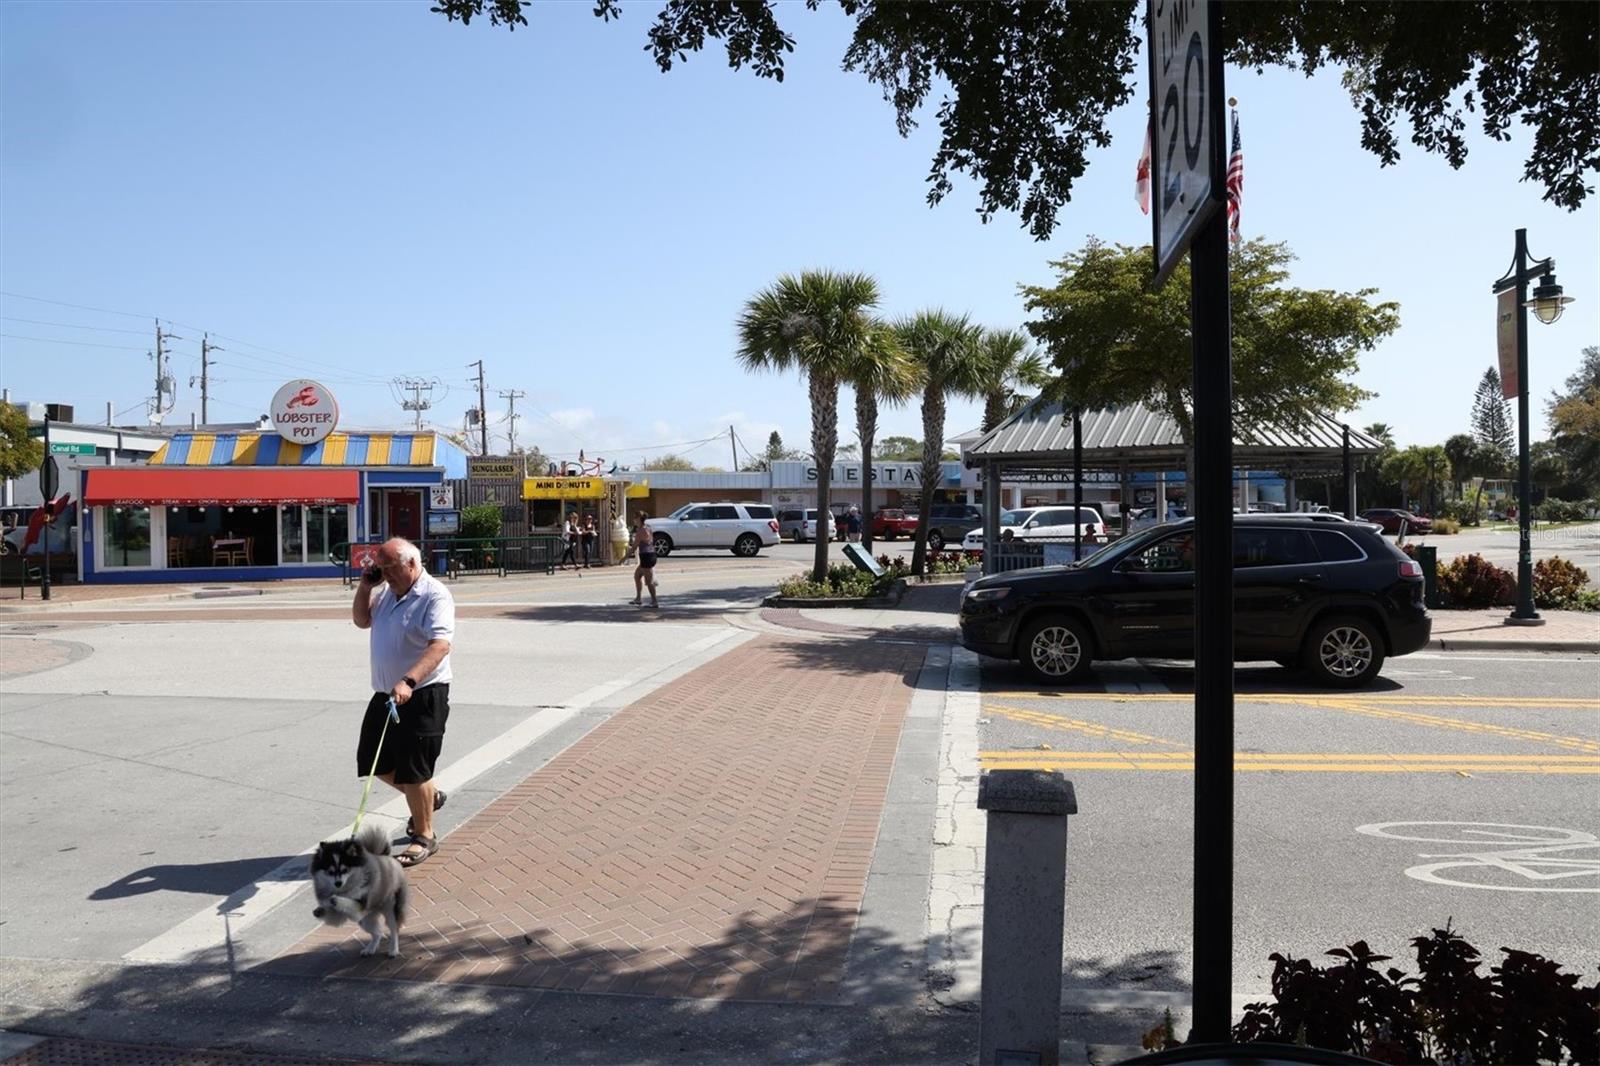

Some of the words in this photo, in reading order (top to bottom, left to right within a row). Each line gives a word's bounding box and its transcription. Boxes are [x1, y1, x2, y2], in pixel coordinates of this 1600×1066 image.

[1161, 31, 1205, 217] 20
[276, 412, 333, 424] LOBSTER
[293, 426, 318, 438] POT
[51, 444, 70, 453] Canal
[70, 444, 80, 453] Rd
[471, 465, 515, 473] SUNGLASSES
[535, 481, 555, 490] MINI
[556, 481, 592, 490] DONUTS
[609, 484, 618, 521] HENNA
